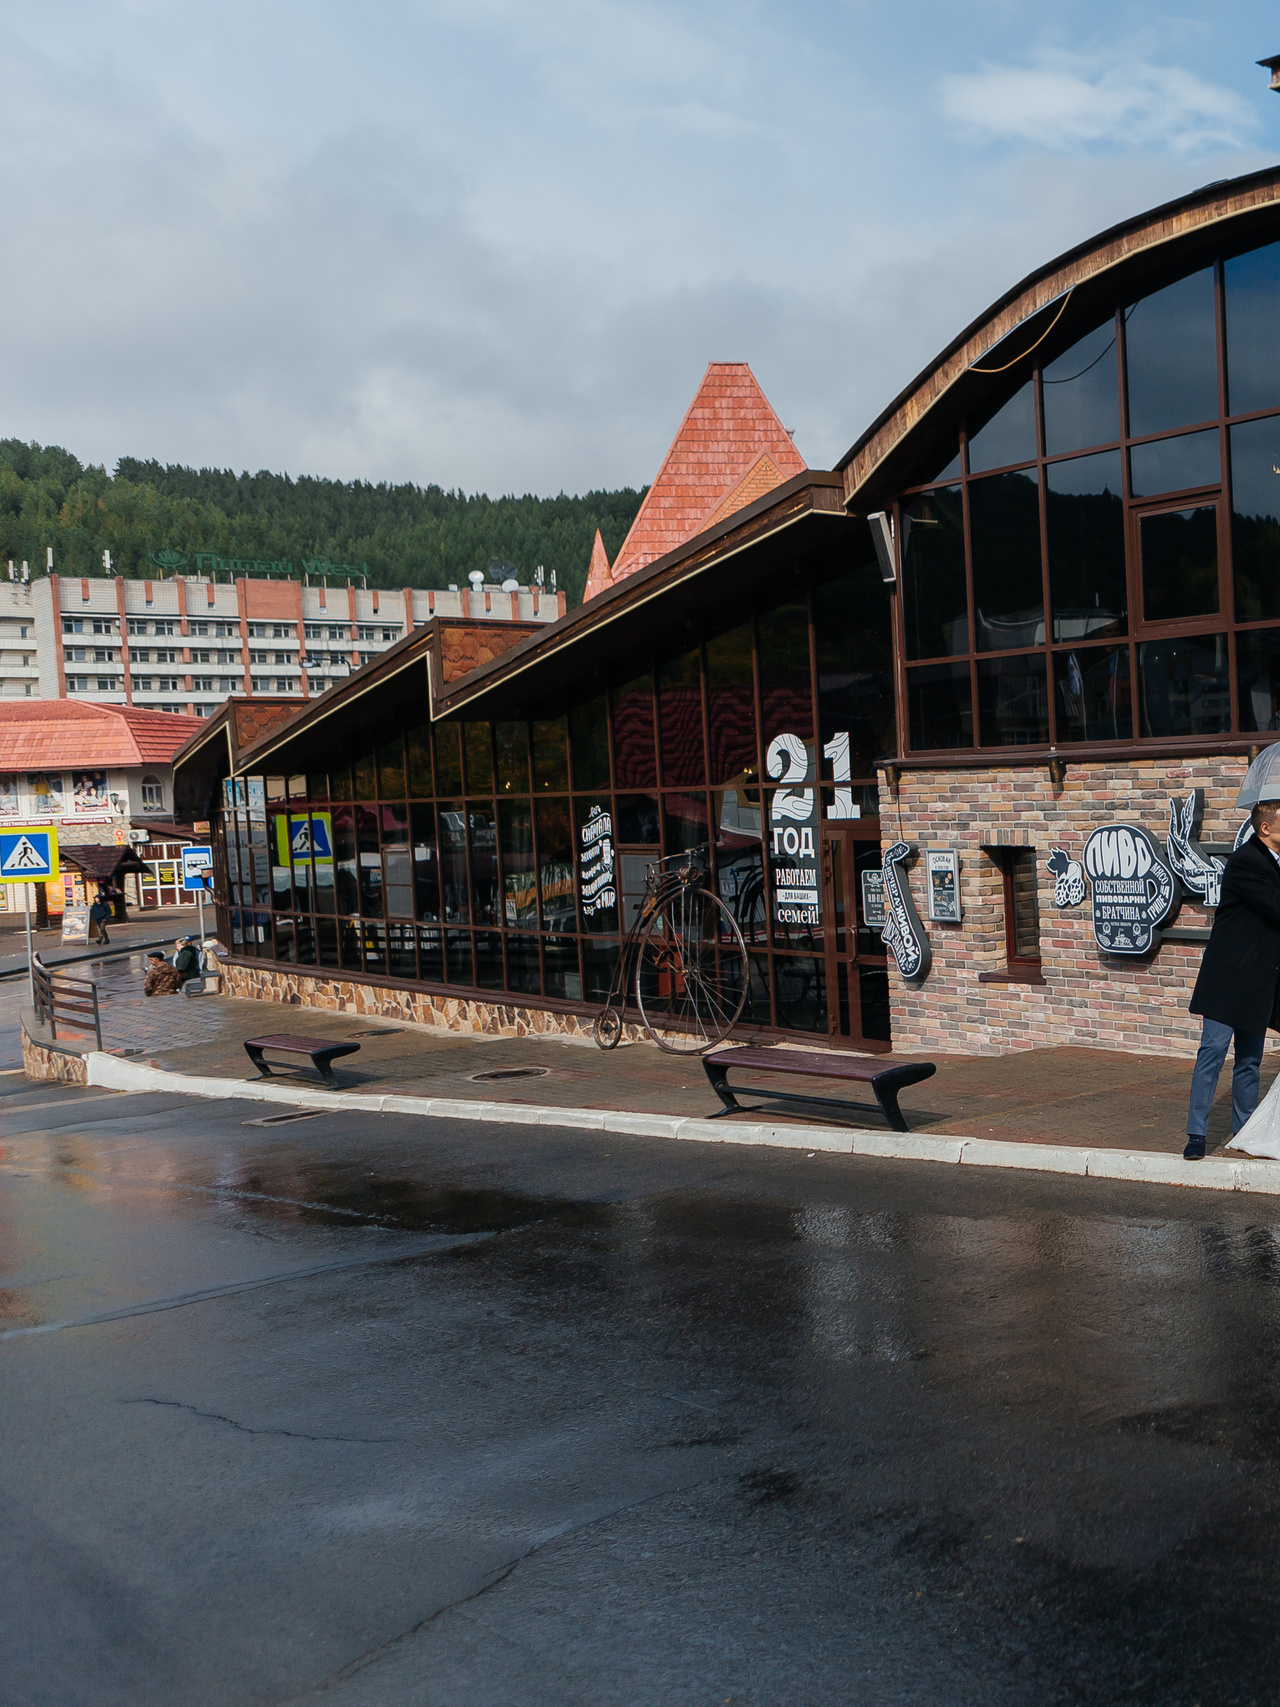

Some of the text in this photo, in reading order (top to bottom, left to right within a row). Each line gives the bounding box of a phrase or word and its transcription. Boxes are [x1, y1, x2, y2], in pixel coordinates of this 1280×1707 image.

[196, 553, 372, 577] Алтай West
[766, 731, 861, 820] 21
[773, 827, 815, 858] ГОД
[1086, 829, 1152, 879] ПИВО
[775, 868, 817, 886] РАБОТАЕМ
[1149, 862, 1169, 885] МЯСО
[1095, 879, 1145, 894] СОБСТВЕННОЙ
[1096, 895, 1146, 904] ПИВОВАРНИ
[777, 905, 820, 924] семей!
[1102, 906, 1140, 920] БРАТЧИНА
